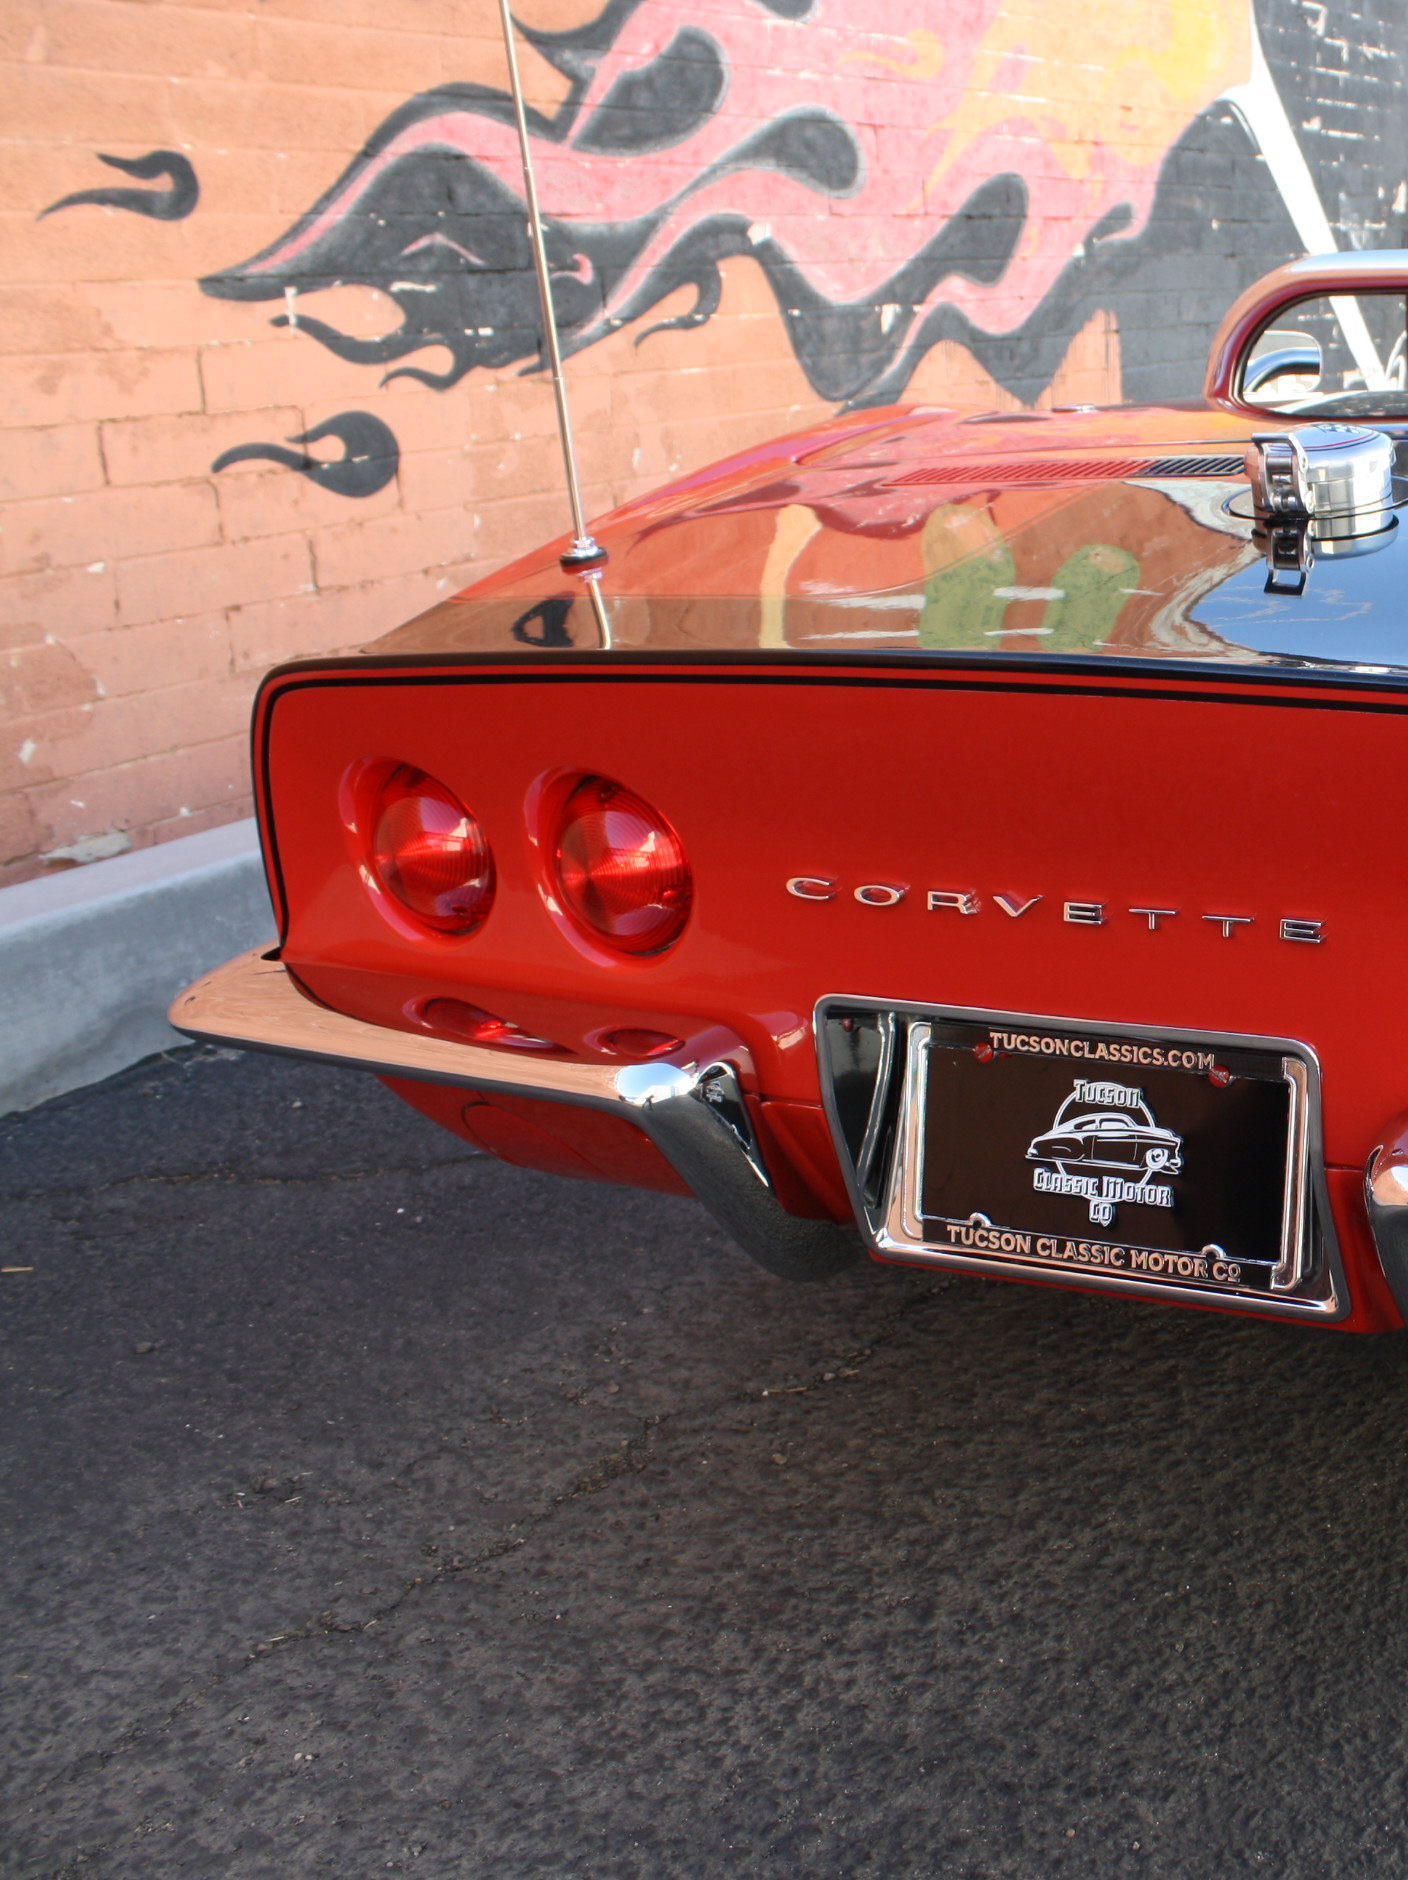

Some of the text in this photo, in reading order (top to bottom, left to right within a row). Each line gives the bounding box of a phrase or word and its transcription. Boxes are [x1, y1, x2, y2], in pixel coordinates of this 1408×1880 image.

[785, 875, 1327, 944] CORVETTE
[989, 1031, 1215, 1070] TUCSONCLASSICS.COM
[1033, 1168, 1173, 1208] CLASSIC MOTOR
[946, 1224, 1032, 1254] TUCSON
[1036, 1237, 1125, 1267] CLASSIC
[1130, 1249, 1209, 1279] MOTOR
